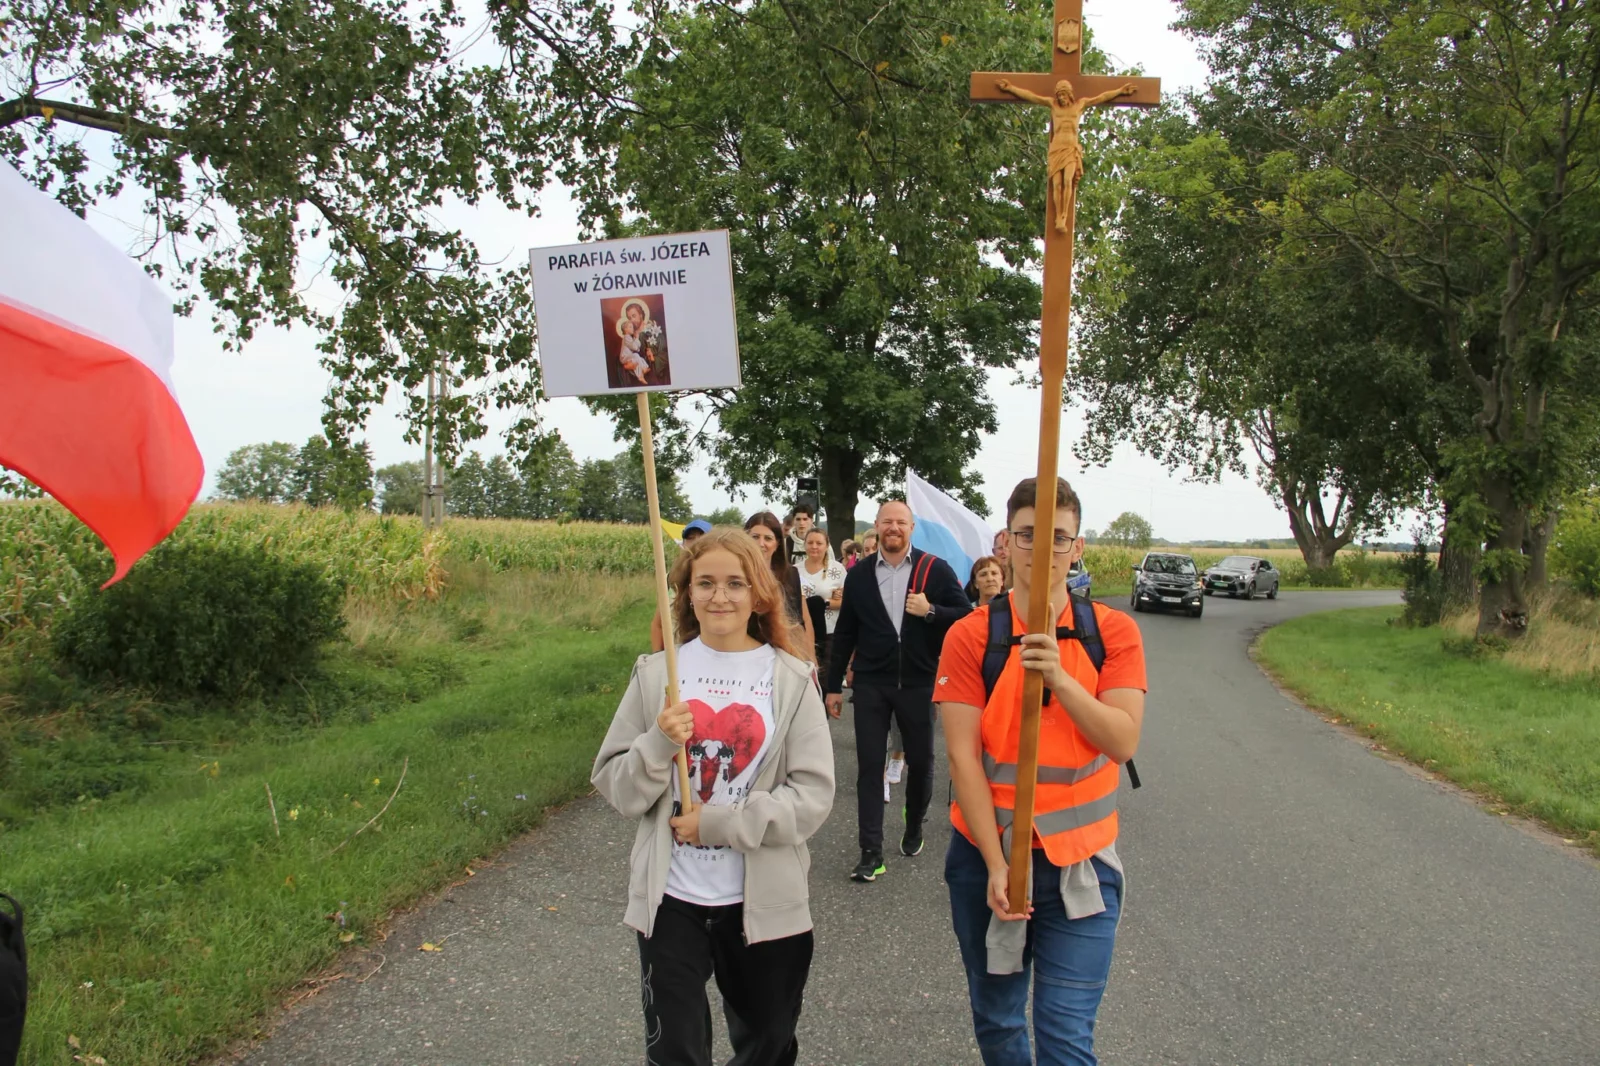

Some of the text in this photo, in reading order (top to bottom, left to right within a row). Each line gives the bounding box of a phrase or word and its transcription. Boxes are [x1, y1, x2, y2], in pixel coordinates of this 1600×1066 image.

[548, 241, 710, 271] PARAFIA św. JÓZEFA
[574, 269, 687, 293] w ŻÓRAWINIE
[938, 676, 949, 686] 4F
